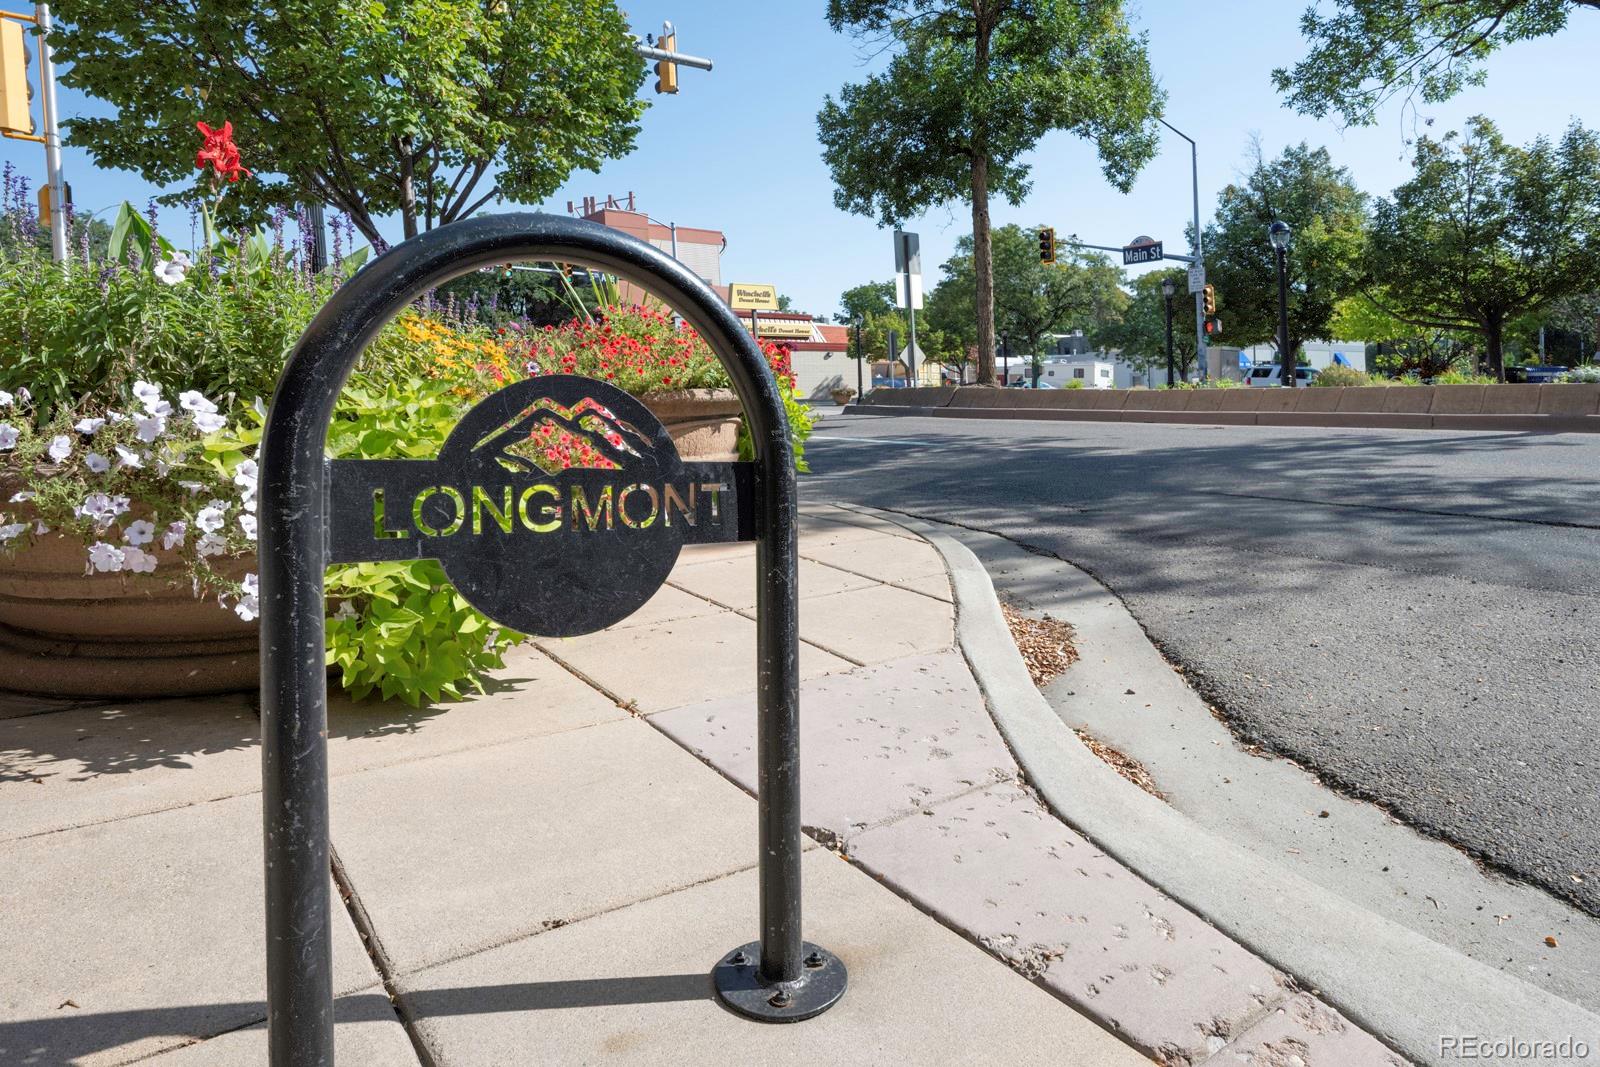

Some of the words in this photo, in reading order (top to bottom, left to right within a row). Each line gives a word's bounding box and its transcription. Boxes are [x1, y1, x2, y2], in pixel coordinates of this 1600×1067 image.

[1125, 248, 1148, 262] Main
[1150, 246, 1161, 259] St
[373, 483, 731, 541] LONGMONT
